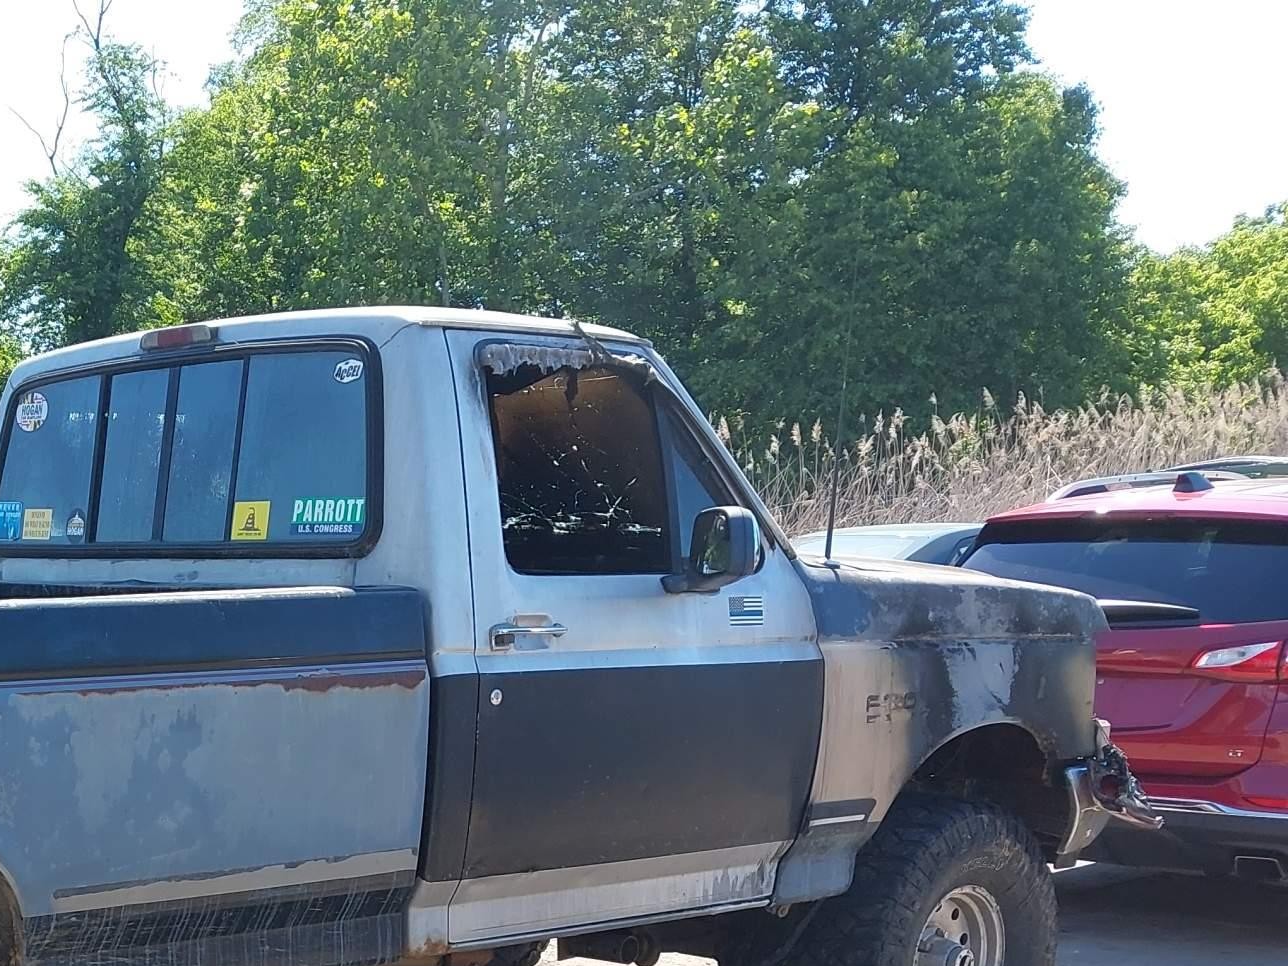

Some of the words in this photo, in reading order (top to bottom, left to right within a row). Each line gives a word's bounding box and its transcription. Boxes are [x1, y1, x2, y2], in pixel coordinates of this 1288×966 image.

[21, 404, 43, 416] HOGAN
[293, 499, 364, 522] PARROTT
[298, 525, 312, 533] U.S.
[314, 524, 352, 533] CONGRESS
